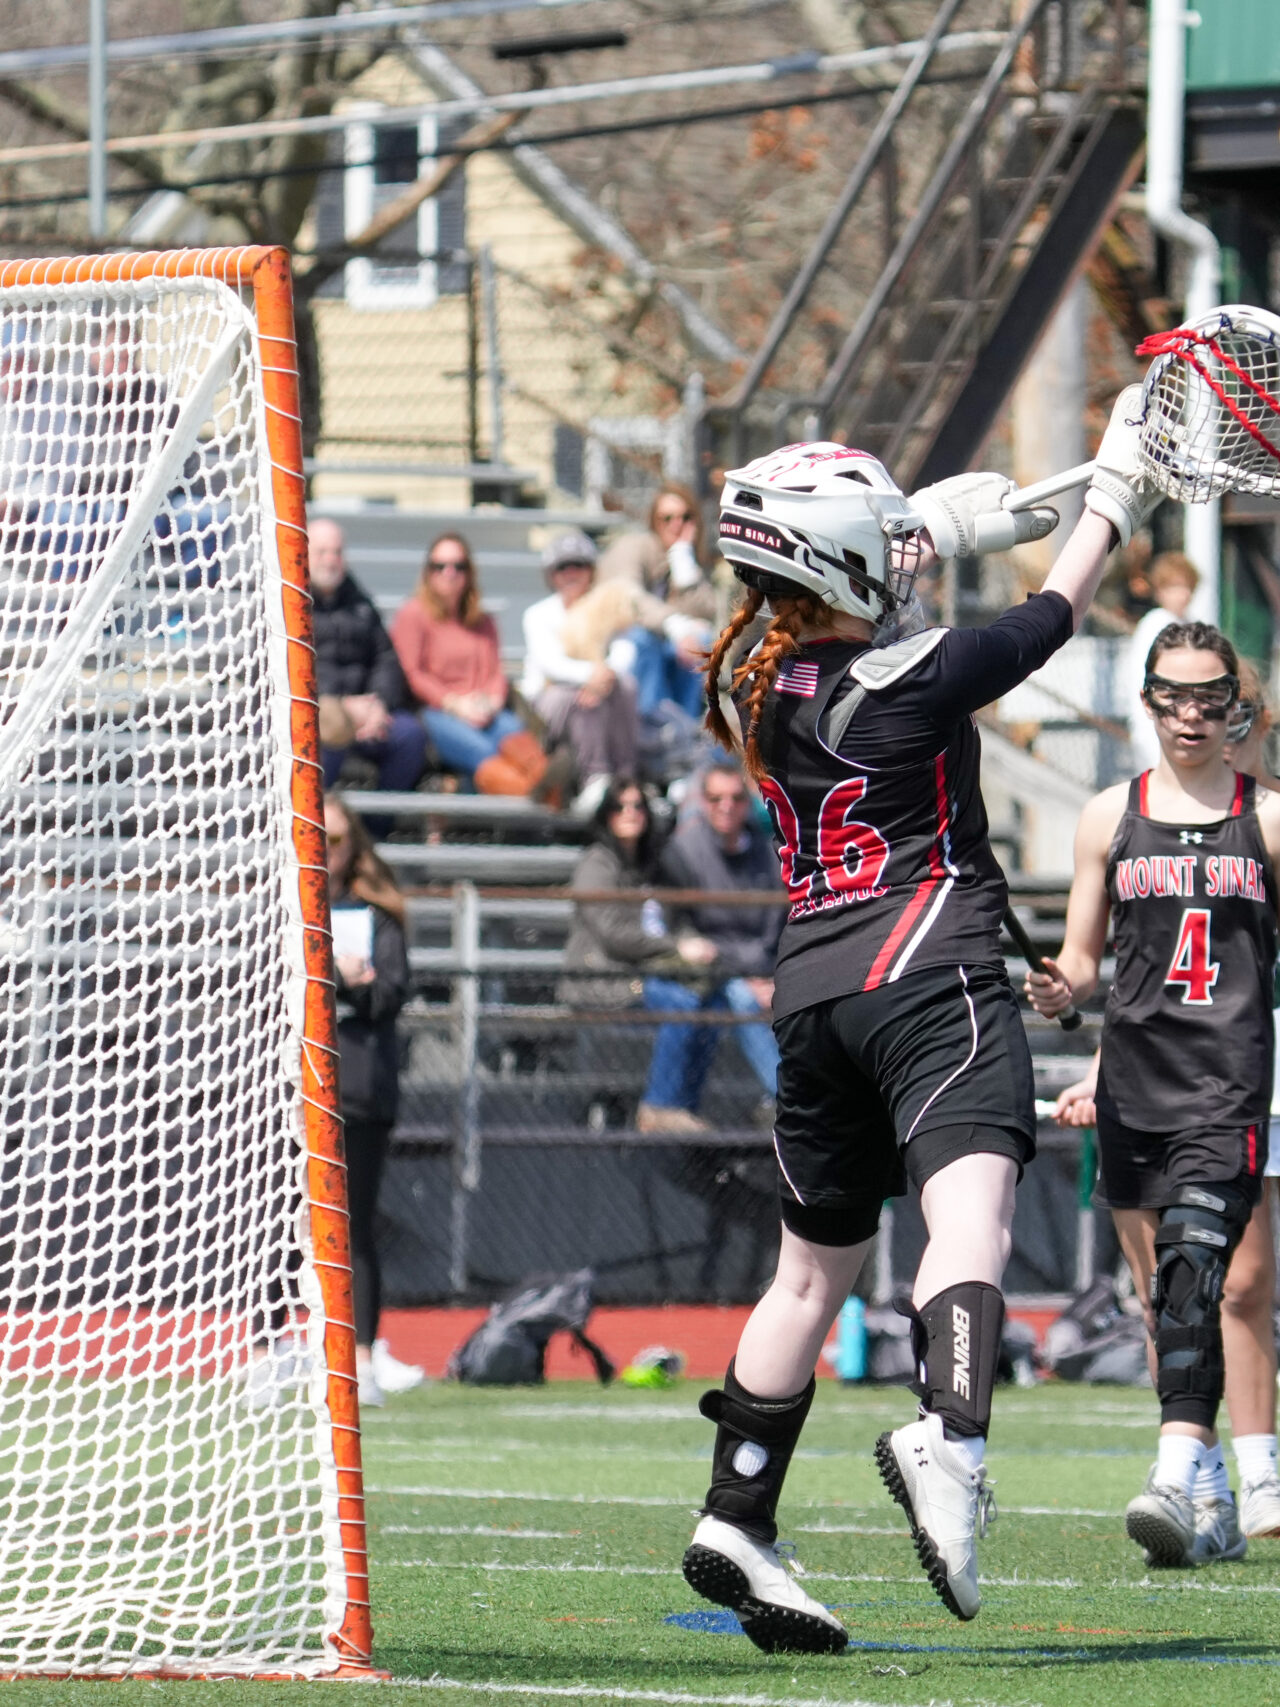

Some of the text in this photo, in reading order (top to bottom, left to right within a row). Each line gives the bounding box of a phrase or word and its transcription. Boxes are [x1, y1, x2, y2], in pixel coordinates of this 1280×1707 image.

[744, 527, 782, 549] SINAI
[758, 776, 890, 902] 26
[1116, 855, 1198, 902] MOUNT
[1164, 908, 1221, 1005] 4
[952, 1304, 970, 1400] BRINE
